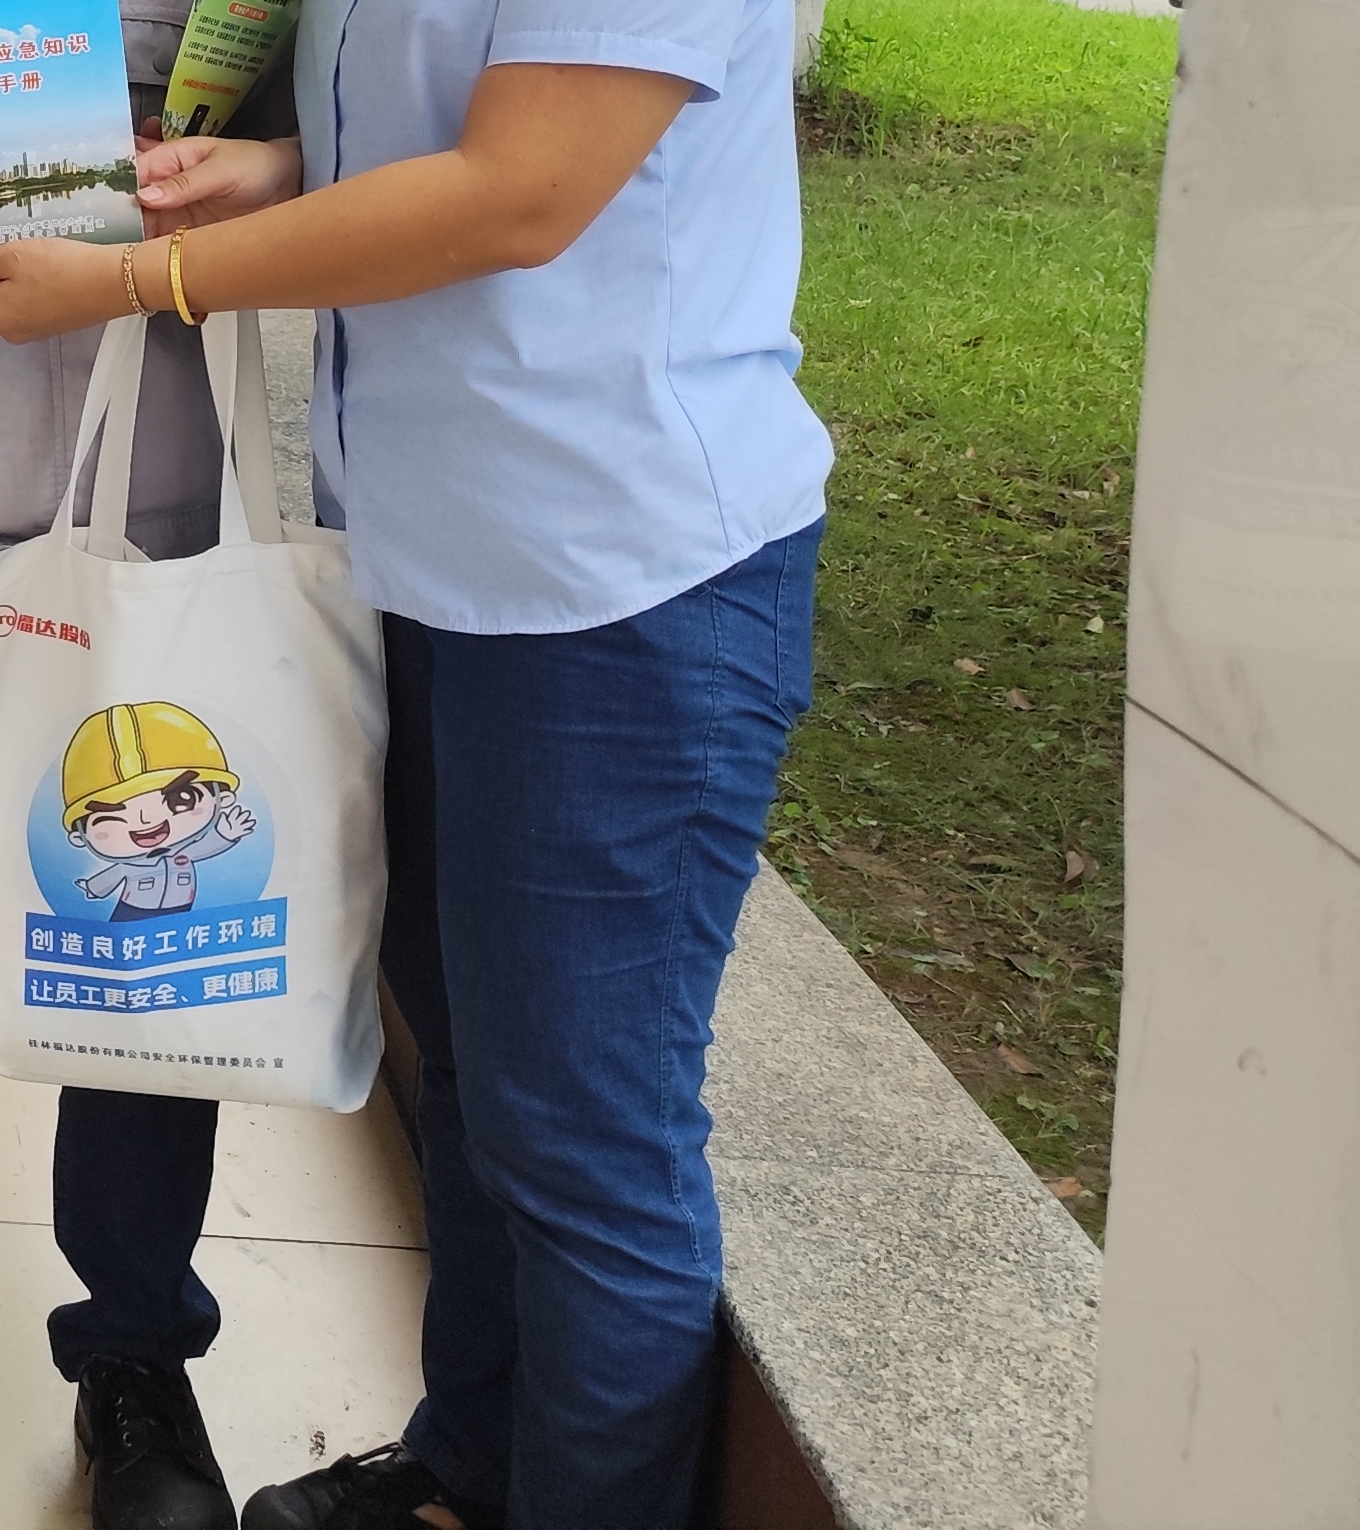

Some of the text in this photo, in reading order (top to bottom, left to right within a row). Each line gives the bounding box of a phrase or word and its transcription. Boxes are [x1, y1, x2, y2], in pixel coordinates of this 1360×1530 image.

[17, 613, 91, 651] 福达股份
[30, 913, 277, 961] 创造良好工作环境
[30, 966, 279, 1010] 让员工更安全、更健康
